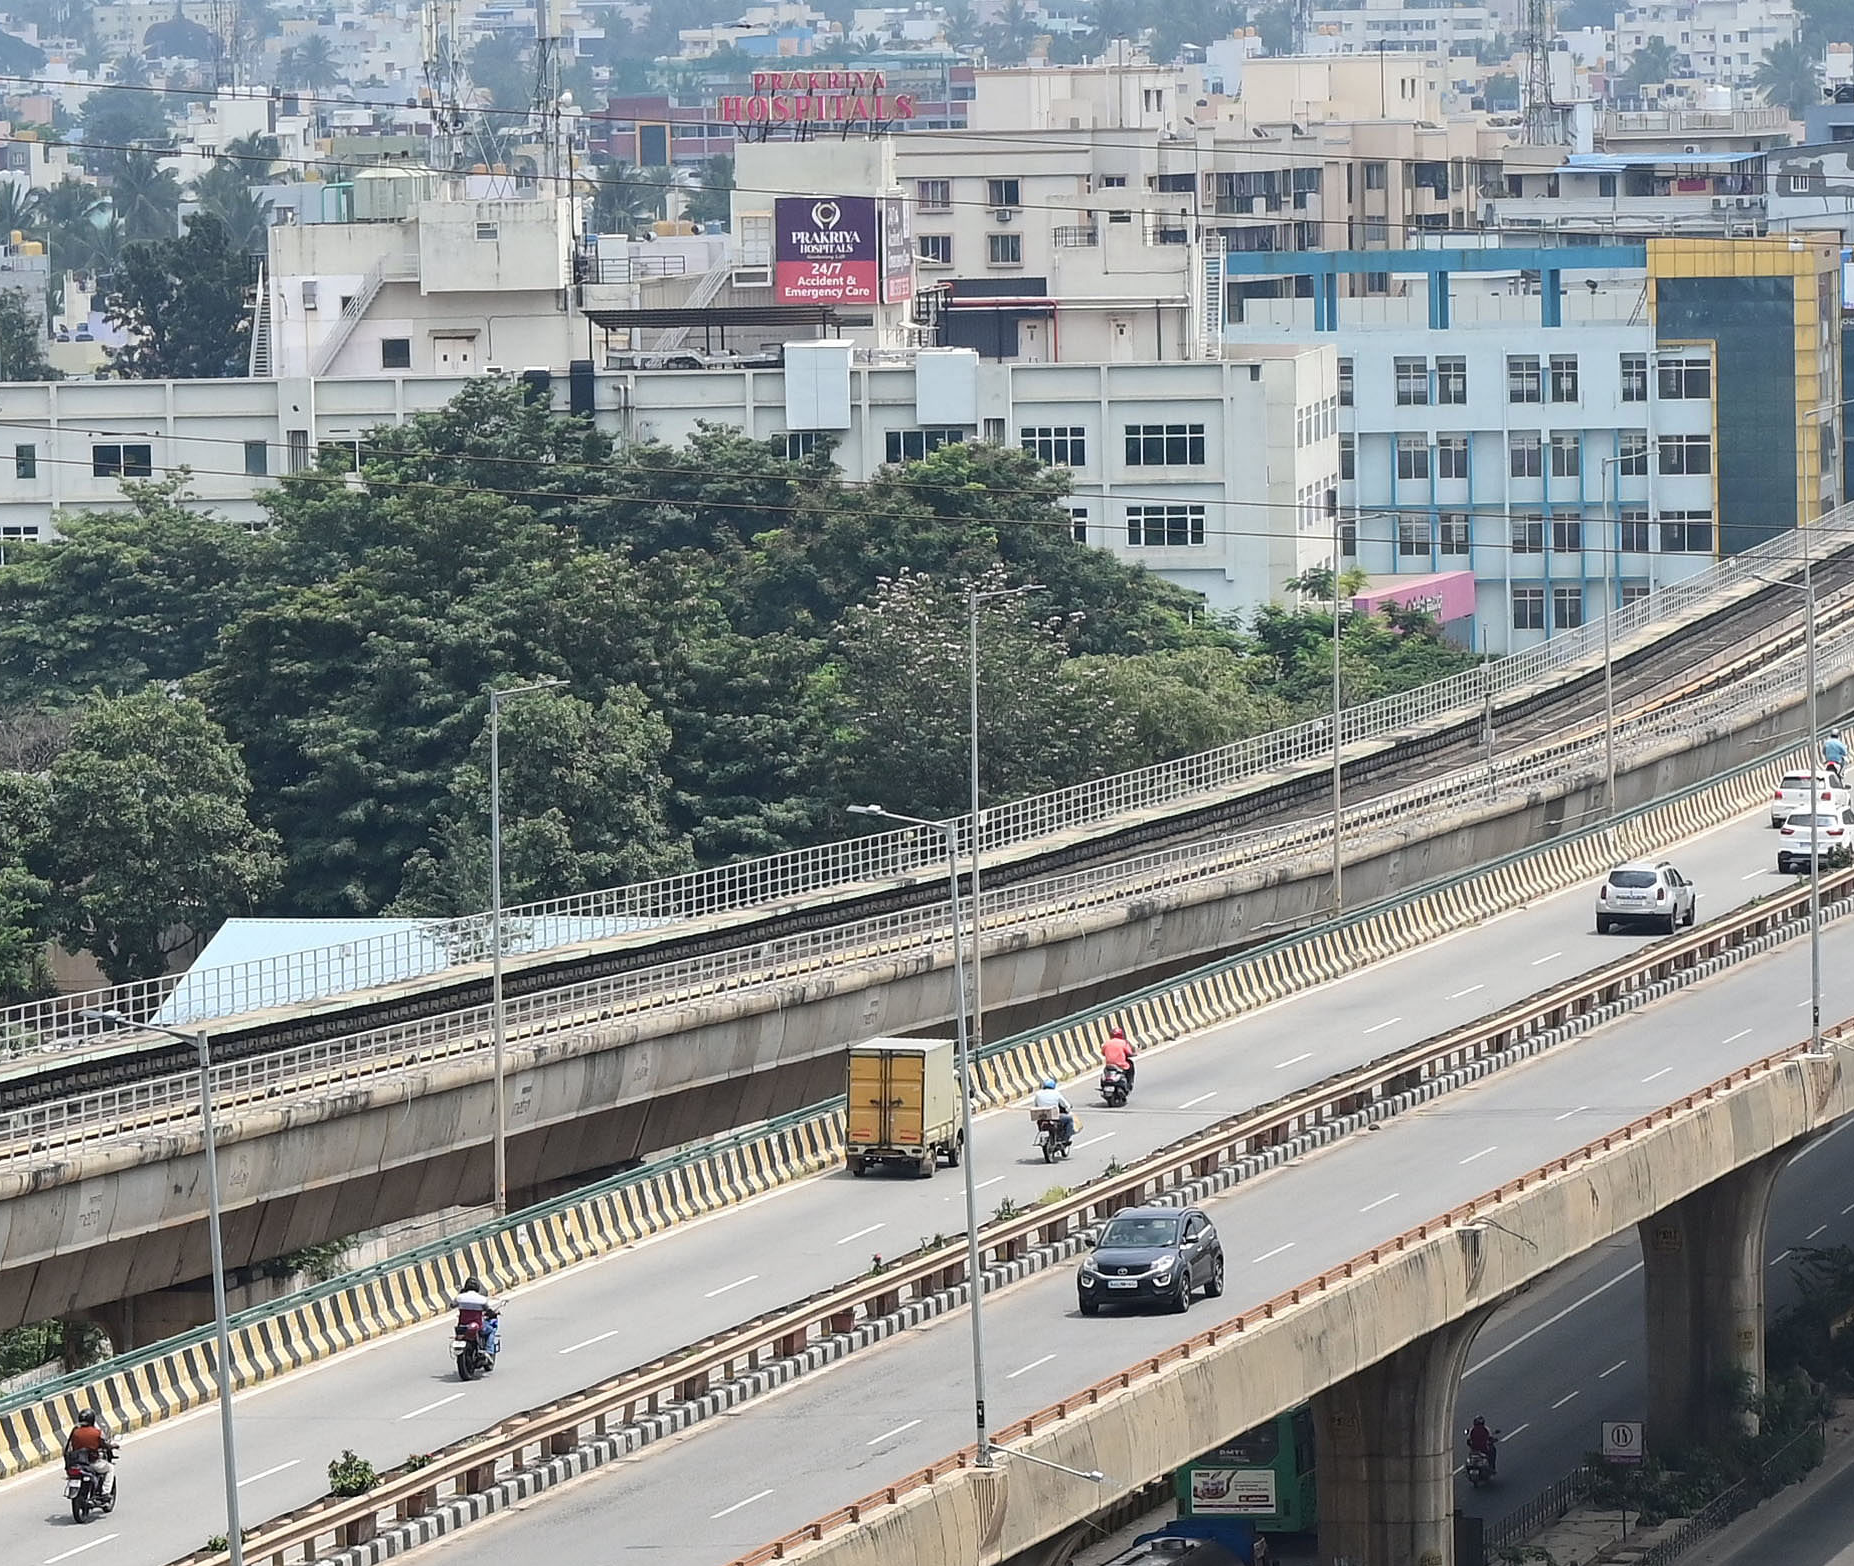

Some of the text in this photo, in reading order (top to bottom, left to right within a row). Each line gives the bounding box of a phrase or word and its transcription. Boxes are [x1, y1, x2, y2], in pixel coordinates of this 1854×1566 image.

[753, 71, 886, 90] PRAKRIYA
[722, 94, 915, 121] HOSPITALS
[791, 231, 861, 244] PRAKRIYA
[800, 244, 854, 254] HOSPITALS
[811, 263, 843, 276] 24/7
[797, 275, 857, 287] Accident &
[785, 287, 870, 298] Emergency Care
